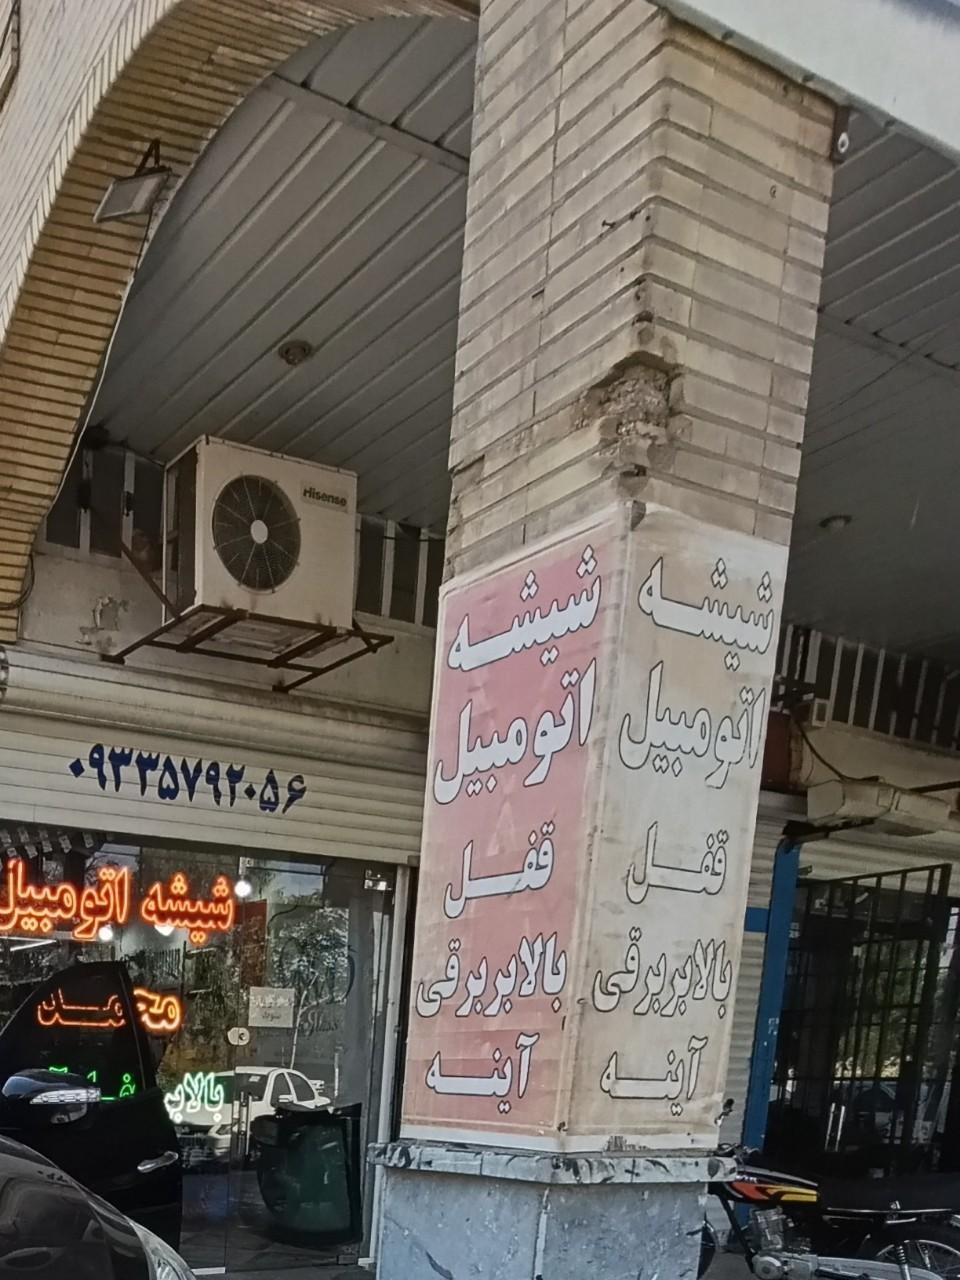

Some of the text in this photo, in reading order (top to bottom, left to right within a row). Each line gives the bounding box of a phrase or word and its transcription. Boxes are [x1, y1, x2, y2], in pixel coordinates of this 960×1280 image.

[303, 486, 347, 507] Hisense
[448, 545, 602, 672] شیشه
[638, 557, 775, 671] شیشه
[433, 658, 597, 805] اتومبیل
[618, 661, 766, 790] اتومبیل
[68, 743, 307, 815] ۰۹۳۳۵۷۹۲۰۵۶
[444, 821, 555, 919] قفل
[626, 821, 729, 904] قفل
[141, 873, 235, 945] شیشه
[425, 1033, 540, 1114] آینه
[600, 1036, 708, 1116] آینه
